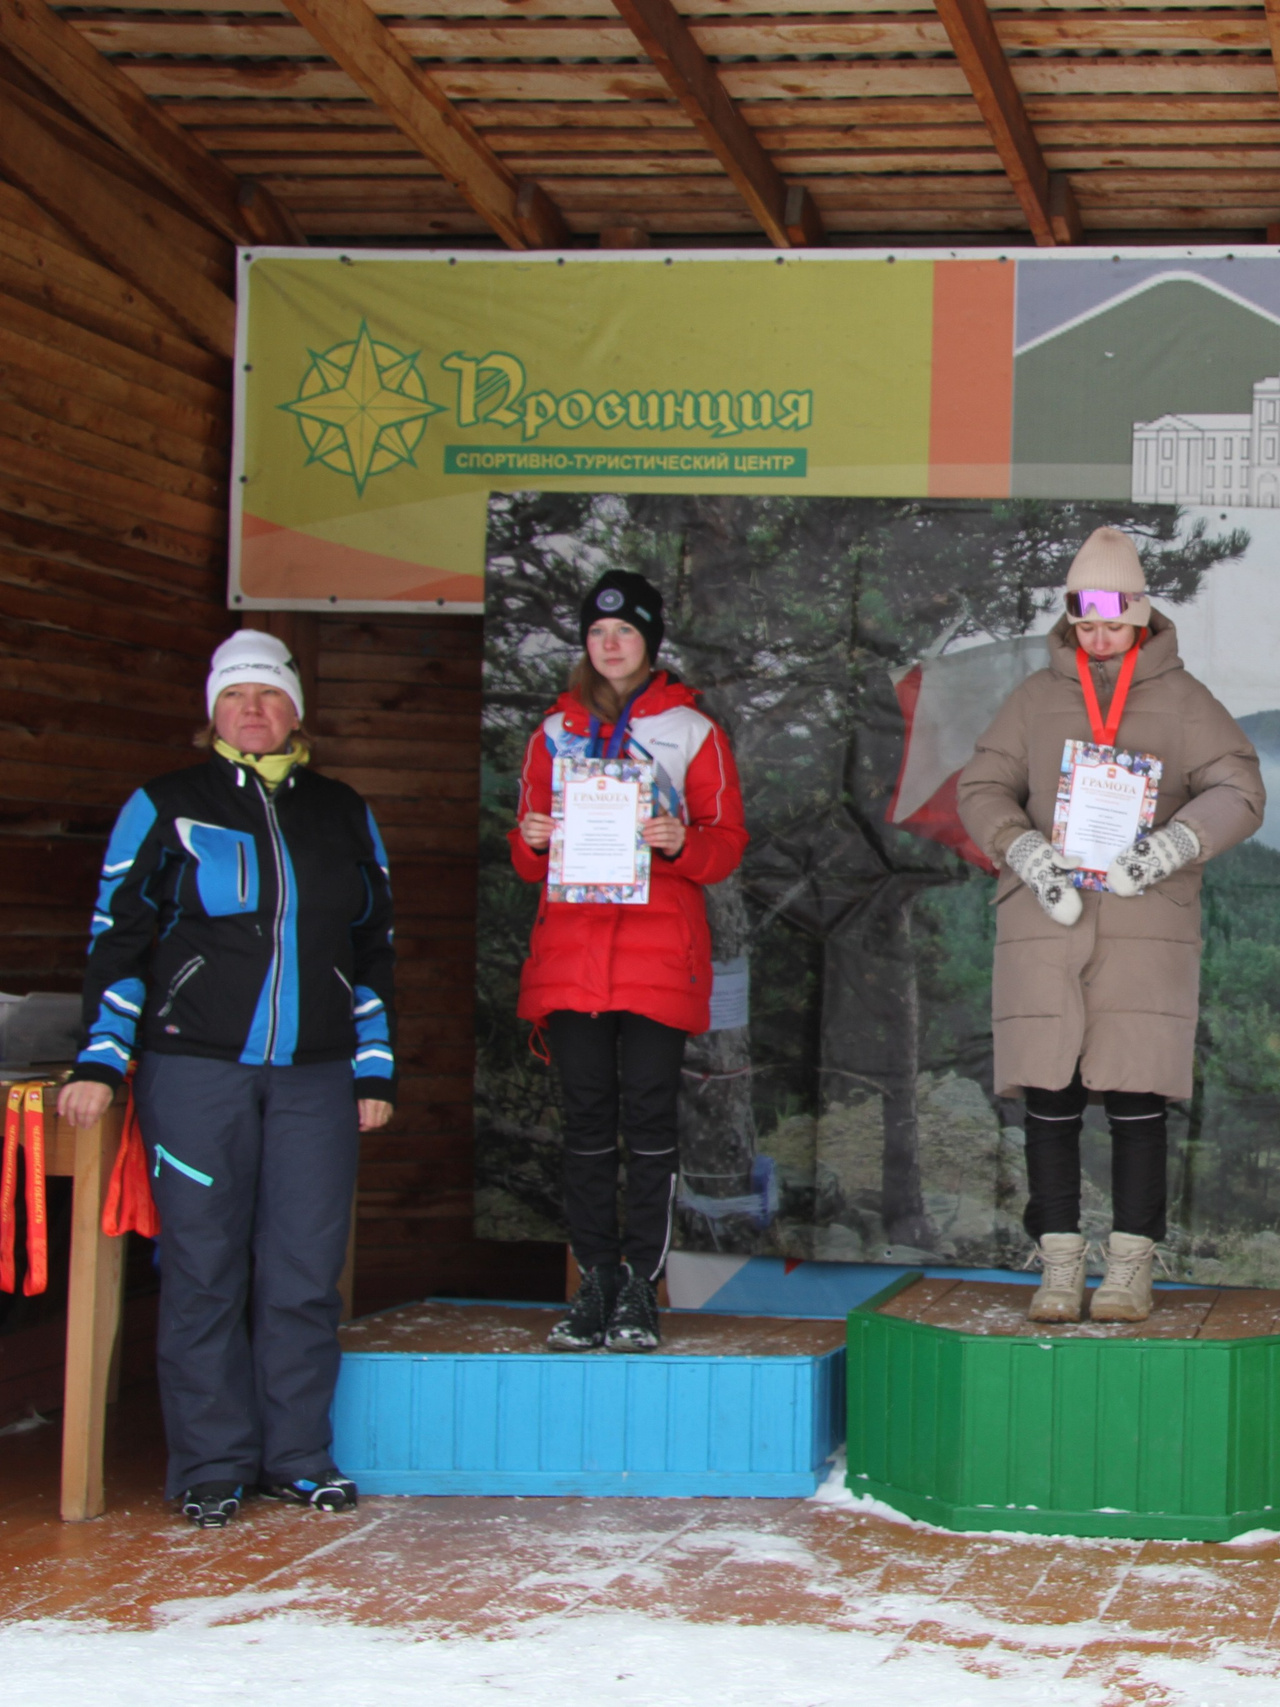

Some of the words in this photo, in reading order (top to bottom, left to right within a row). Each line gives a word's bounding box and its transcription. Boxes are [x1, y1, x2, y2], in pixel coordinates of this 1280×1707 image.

[440, 350, 813, 443] Провинция
[455, 450, 730, 472] СПОРТИВНО-ТУРИСТИЧЕСКИЙ
[734, 455, 796, 473] ЦЕНТР
[1081, 776, 1137, 795] ГРАМОТА
[573, 792, 630, 802] ГРАМОТА
